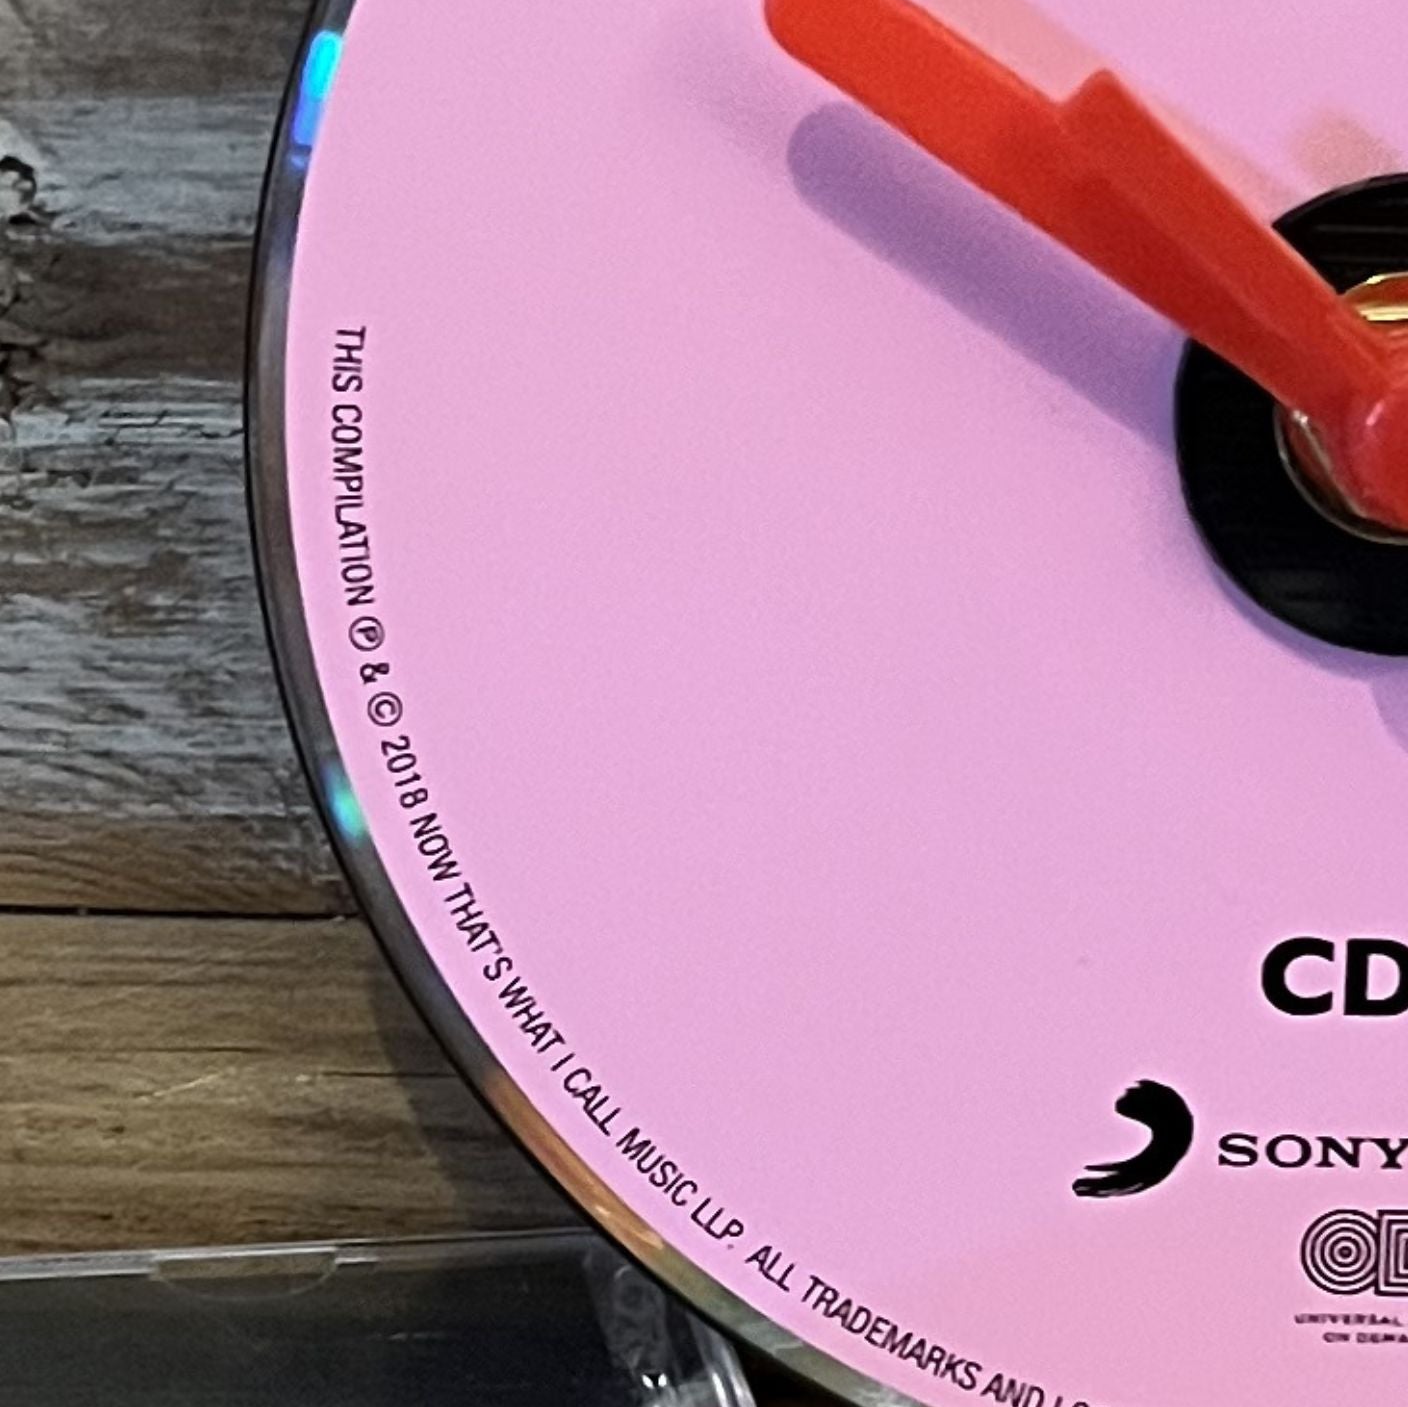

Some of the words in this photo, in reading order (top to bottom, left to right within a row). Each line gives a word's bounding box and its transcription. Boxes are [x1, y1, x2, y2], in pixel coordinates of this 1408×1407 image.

[330, 324, 368, 393] THIS
[330, 403, 376, 607] COMPILATION
[380, 734, 429, 810] 2018
[408, 812, 463, 882] NOW
[443, 881, 514, 982] THAT'S
[497, 975, 567, 1054] WHAT
[549, 1052, 576, 1072] I
[563, 1067, 622, 1137] CALL
[615, 1126, 699, 1207] MUSIC
[744, 1245, 796, 1293] ALL
[800, 1274, 984, 1391] TRADEMARKS
